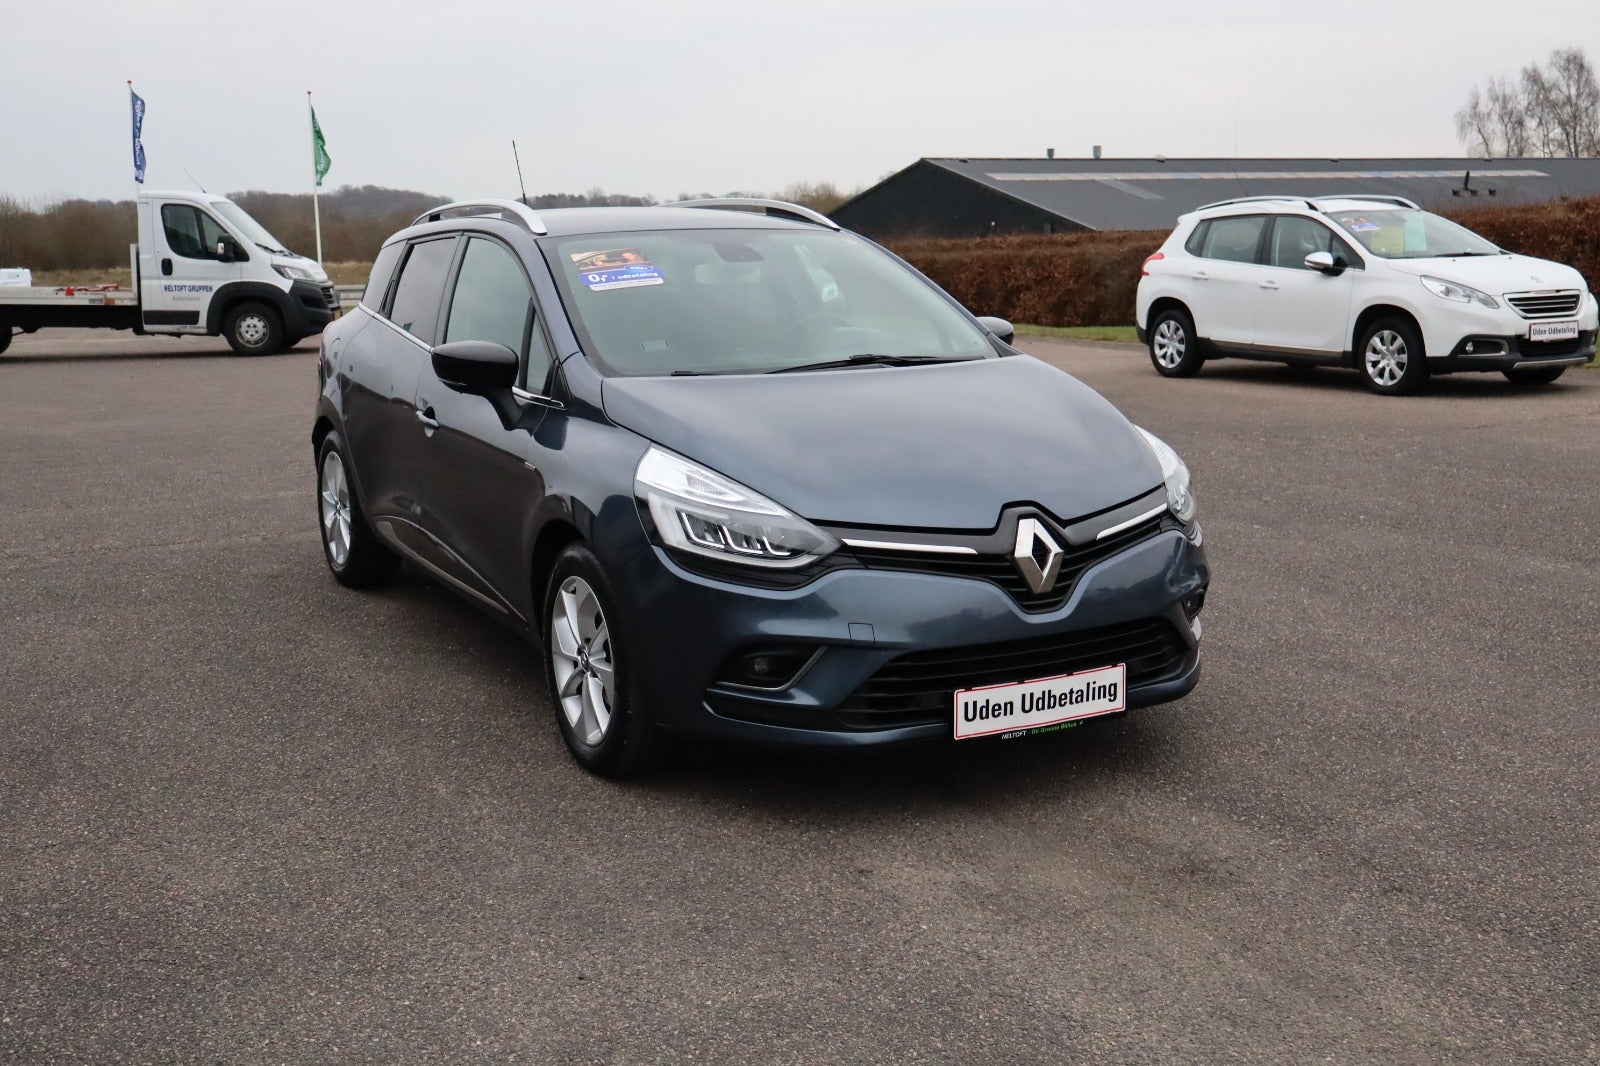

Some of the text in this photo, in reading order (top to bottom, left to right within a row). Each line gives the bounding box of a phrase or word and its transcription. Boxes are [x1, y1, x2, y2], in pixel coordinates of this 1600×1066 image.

[1532, 326, 1576, 336] Uden Udbetaling
[963, 681, 1118, 722] Uden Udbetaling
